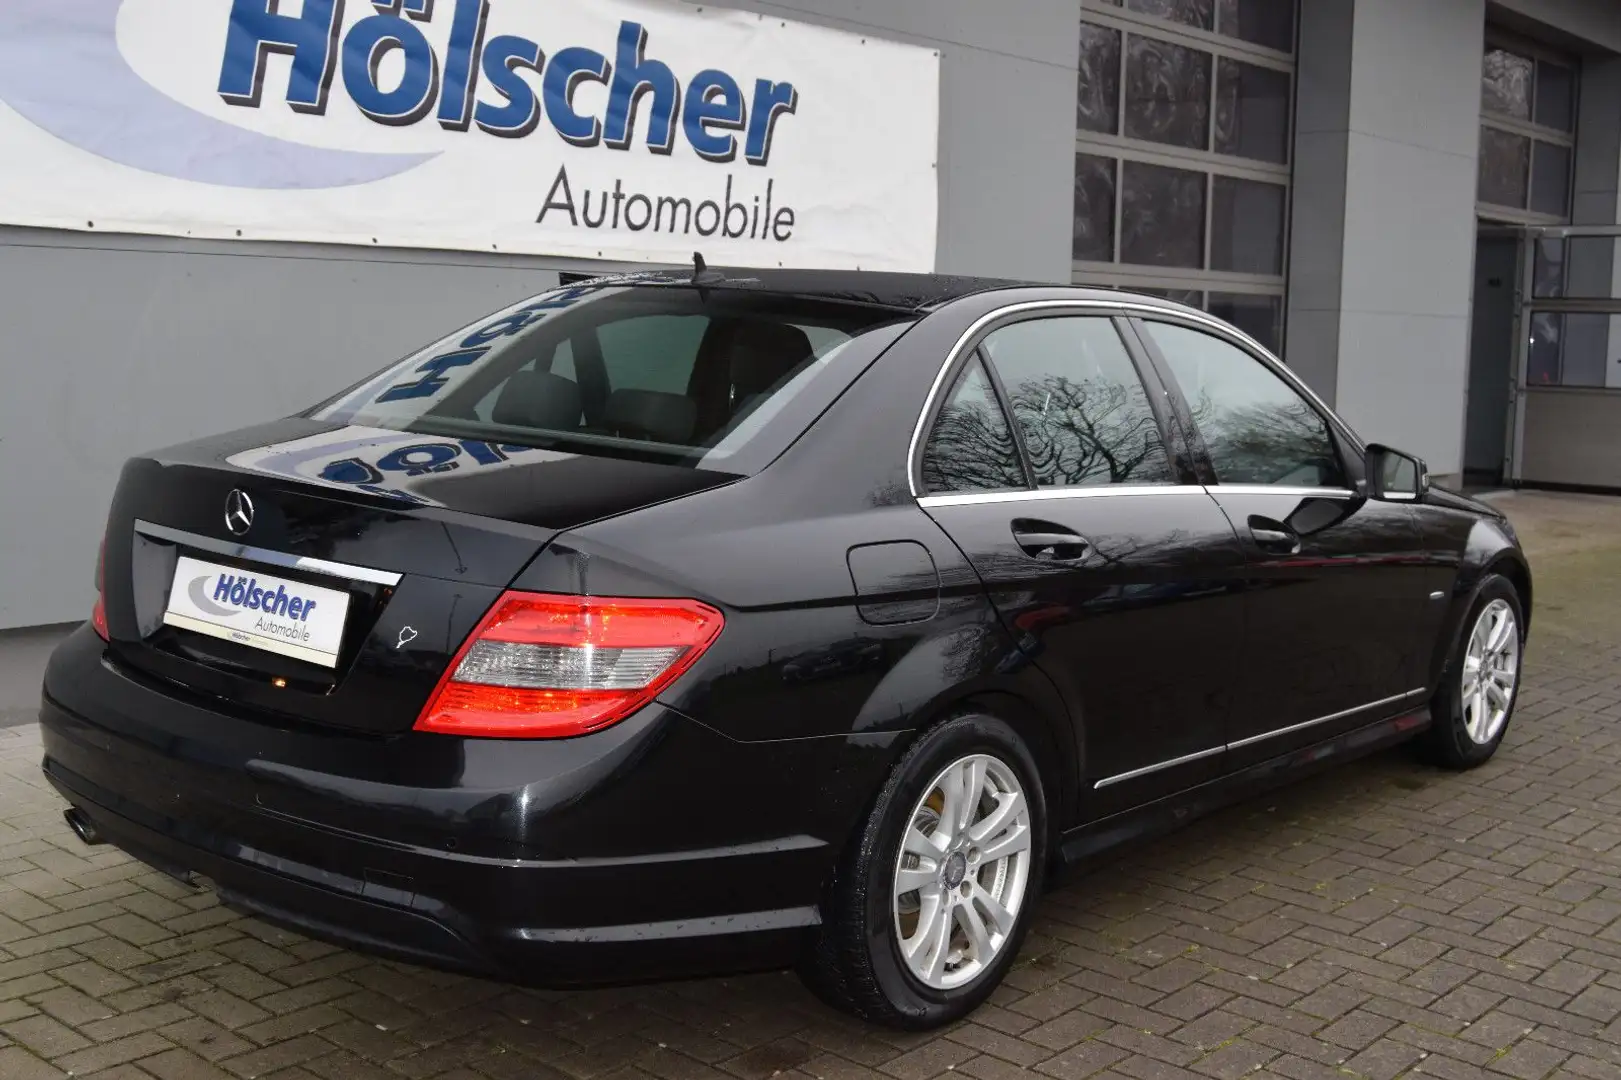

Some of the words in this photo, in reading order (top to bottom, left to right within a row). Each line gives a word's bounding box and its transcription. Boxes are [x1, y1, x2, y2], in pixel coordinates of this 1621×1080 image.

[217, 0, 798, 166] Hölscher
[535, 163, 795, 241] Automobile
[213, 573, 317, 622] Hölscher
[254, 616, 311, 642] Automobile
